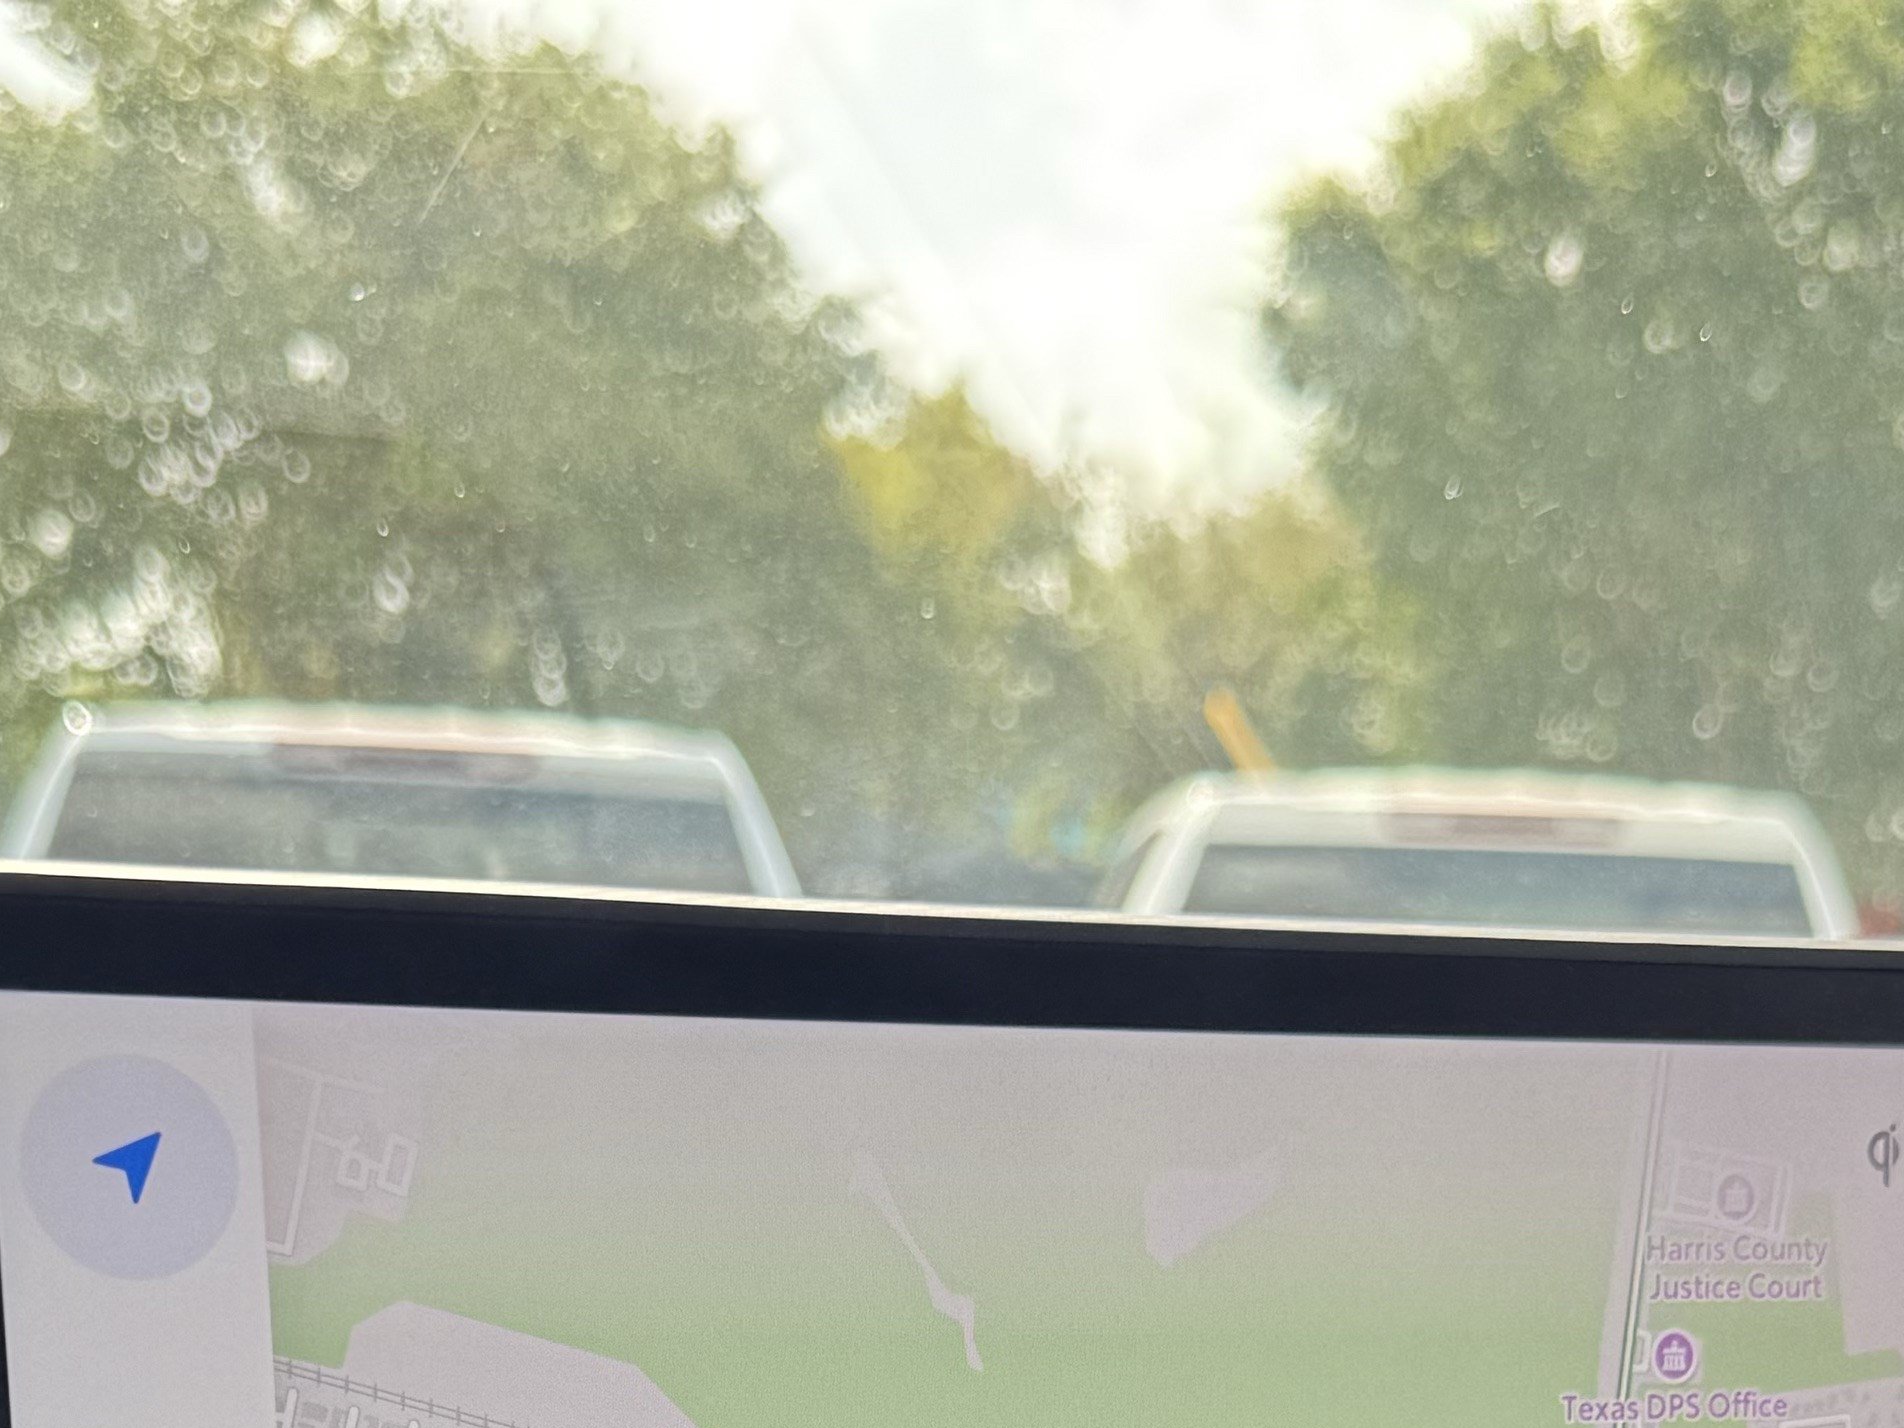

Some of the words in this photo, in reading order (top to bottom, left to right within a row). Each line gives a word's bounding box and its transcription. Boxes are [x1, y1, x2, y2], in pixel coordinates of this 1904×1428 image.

[1646, 1235, 1726, 1266] Harris
[1733, 1234, 1828, 1267] County
[1649, 1273, 1741, 1301] Justice
[1747, 1272, 1823, 1300] Court
[1563, 1396, 1640, 1423] Texas
[1646, 1394, 1701, 1421] DPS
[1708, 1392, 1788, 1420] Office
